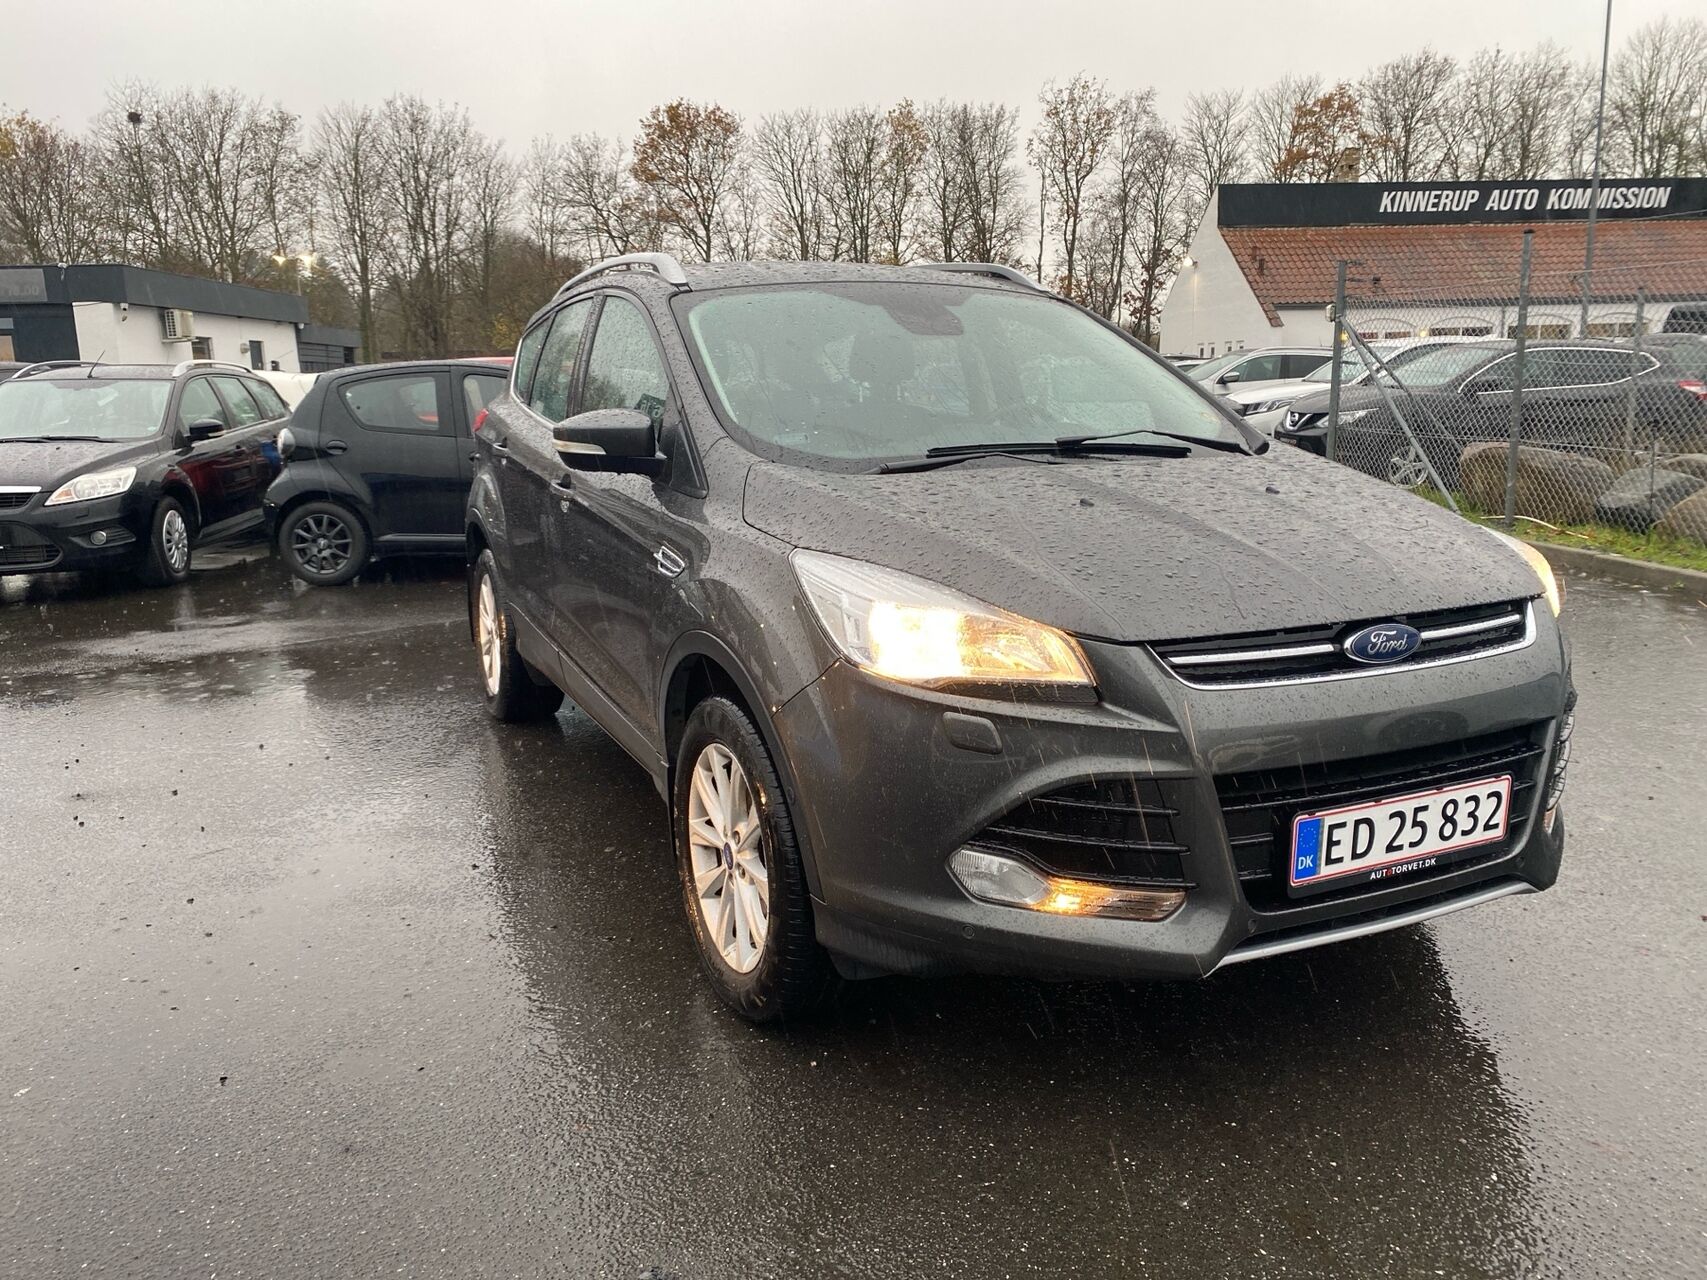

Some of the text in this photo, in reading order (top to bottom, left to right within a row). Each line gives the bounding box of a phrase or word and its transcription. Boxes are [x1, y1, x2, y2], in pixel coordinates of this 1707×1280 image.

[1379, 186, 1672, 213] KINNERUP AUTO KOMMISSION
[1367, 630, 1408, 655] Ford
[1325, 790, 1503, 867] ED 25 832
[1298, 856, 1314, 870] DK
